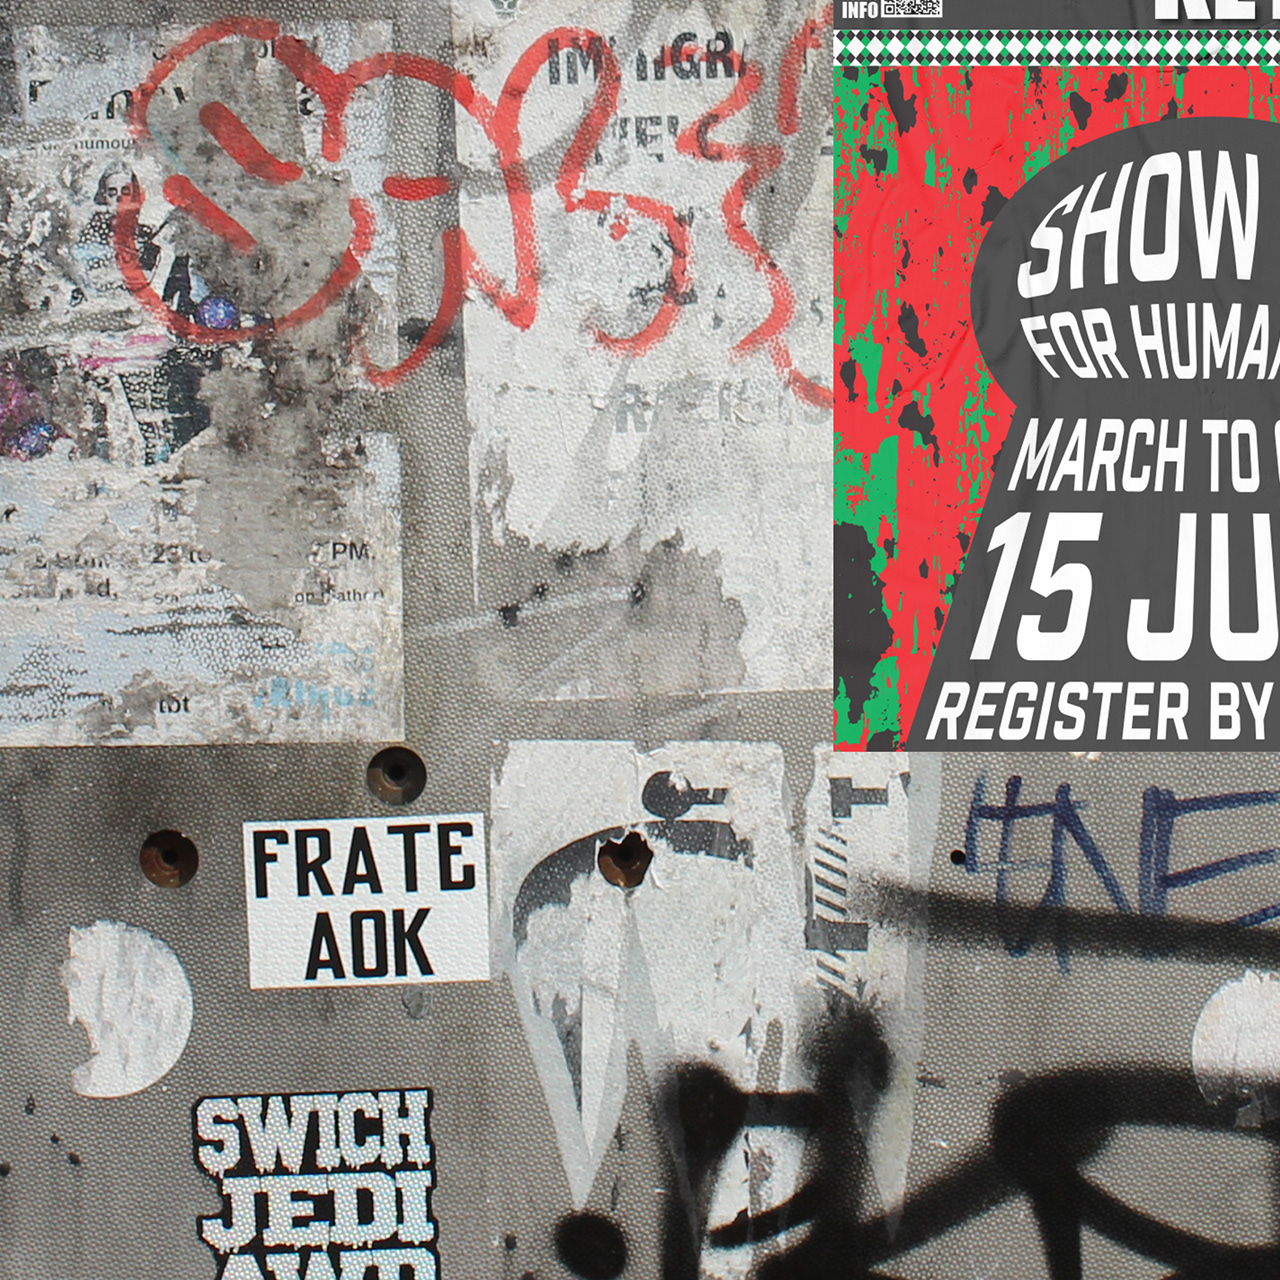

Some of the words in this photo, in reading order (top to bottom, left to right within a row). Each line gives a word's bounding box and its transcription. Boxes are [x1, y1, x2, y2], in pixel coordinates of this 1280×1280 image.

[841, 1, 879, 19] INFO
[1017, 149, 1260, 299] SHOW
[1019, 307, 1128, 379] FOR
[1007, 417, 1188, 493] MARCH
[1201, 419, 1260, 493] TO
[969, 511, 1104, 661] 15
[925, 681, 1190, 741] REGISTER
[1209, 681, 1275, 741] BY
[252, 821, 477, 899] FRATE
[304, 907, 436, 981] AOK
[196, 1090, 432, 1179] SWICH
[202, 1170, 436, 1255] JEDI
